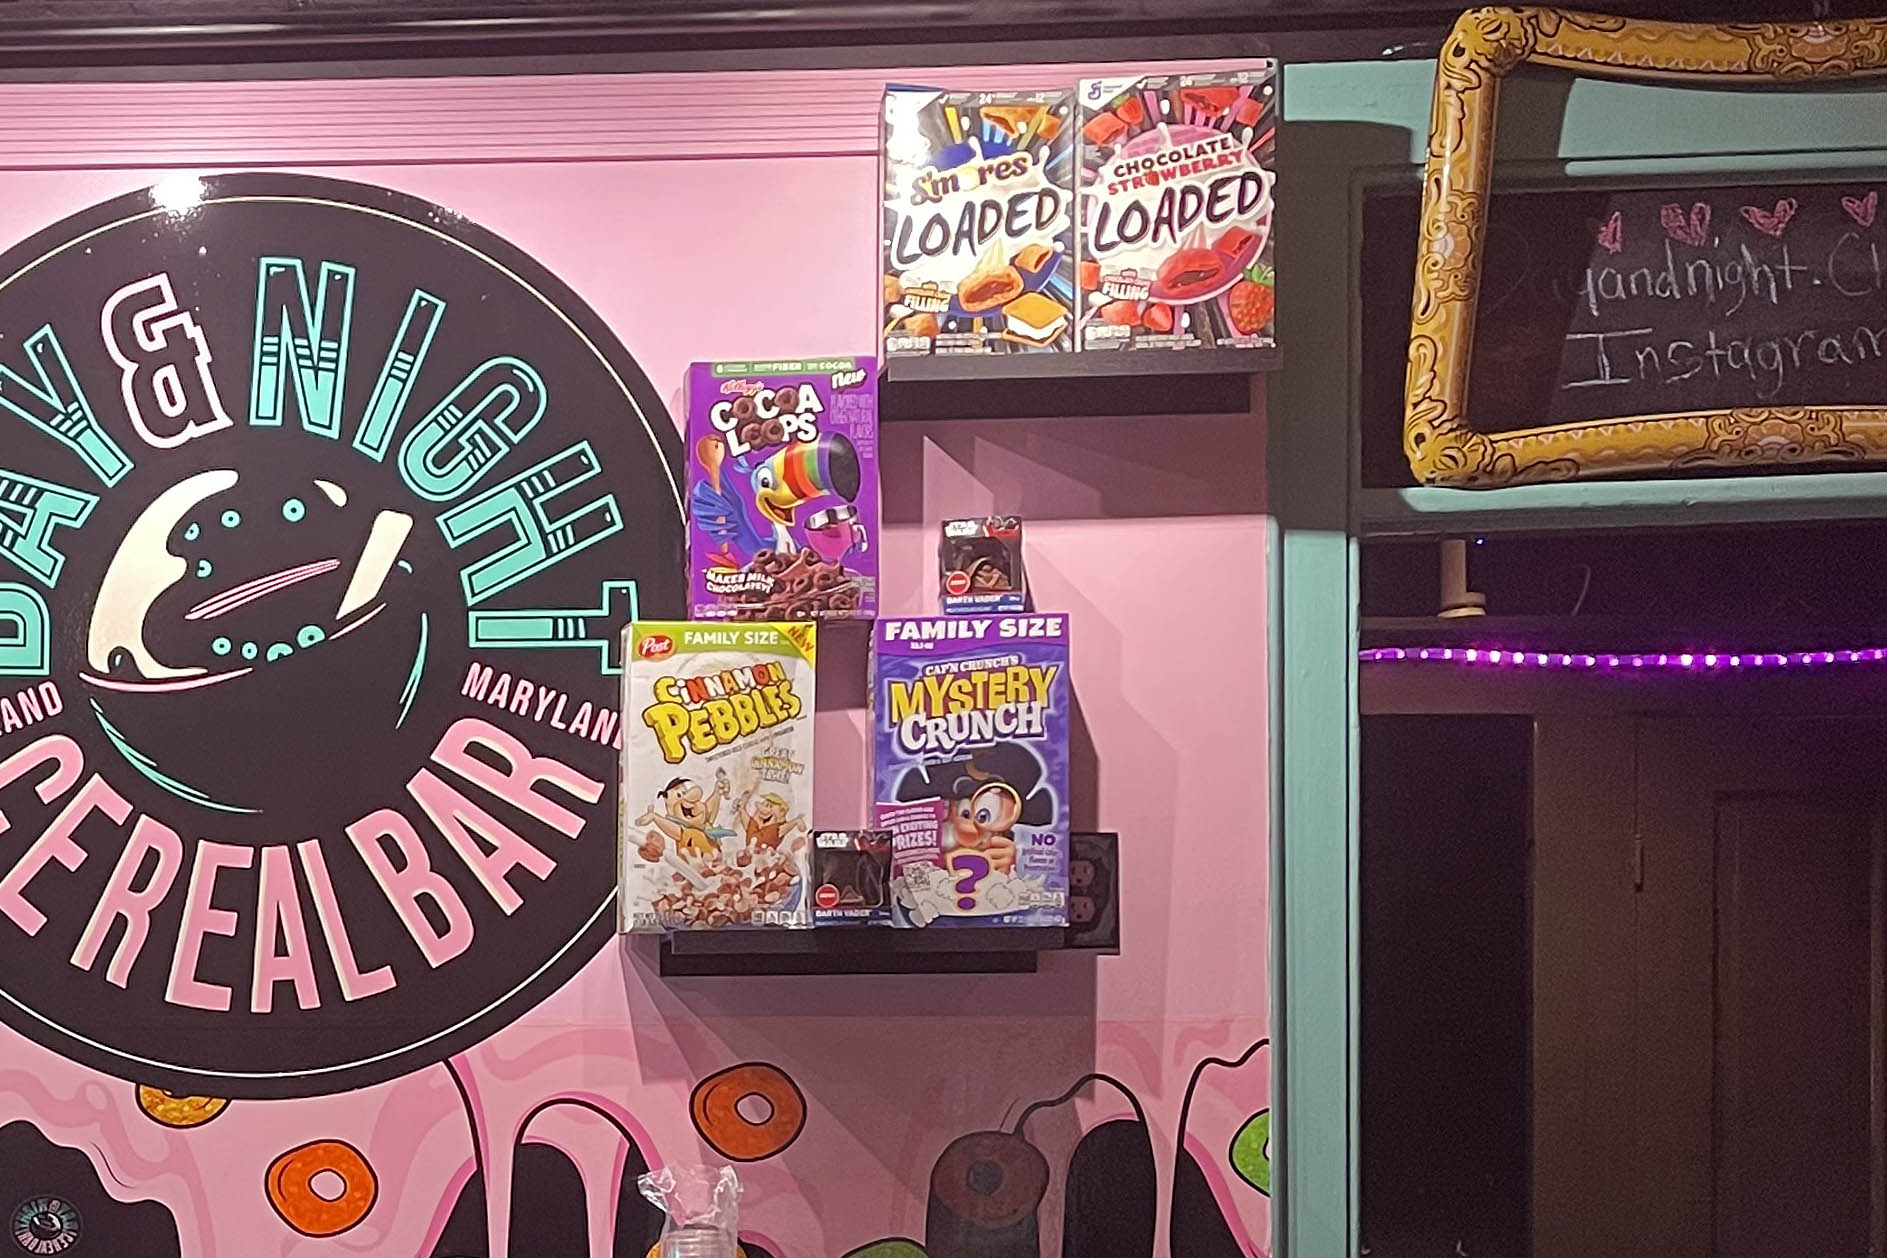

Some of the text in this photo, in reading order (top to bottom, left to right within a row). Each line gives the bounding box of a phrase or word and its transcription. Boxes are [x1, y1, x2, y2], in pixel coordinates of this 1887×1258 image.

[1113, 135, 1233, 180] CHOCOLATE
[1092, 171, 1264, 253] LOADED
[895, 187, 1060, 265] LOADED
[903, 293, 950, 313] FILLING
[1102, 280, 1151, 300] FILLING
[819, 361, 853, 370] COCOA
[831, 368, 867, 390] New
[101, 271, 233, 450] &
[248, 255, 640, 677] NIGHT
[684, 631, 779, 645] FAMILY SIZE
[787, 624, 814, 653] NEW
[885, 617, 1063, 641] FAMILY SIZE
[641, 637, 670, 655] Post
[925, 655, 1019, 677] CAP'N CRUNCH'S
[890, 665, 1059, 724] MYSTERY
[641, 679, 803, 765] PEBBLES
[900, 700, 1044, 751] CRUNCH
[345, 715, 607, 971] BAR
[1030, 833, 1057, 846] NO
